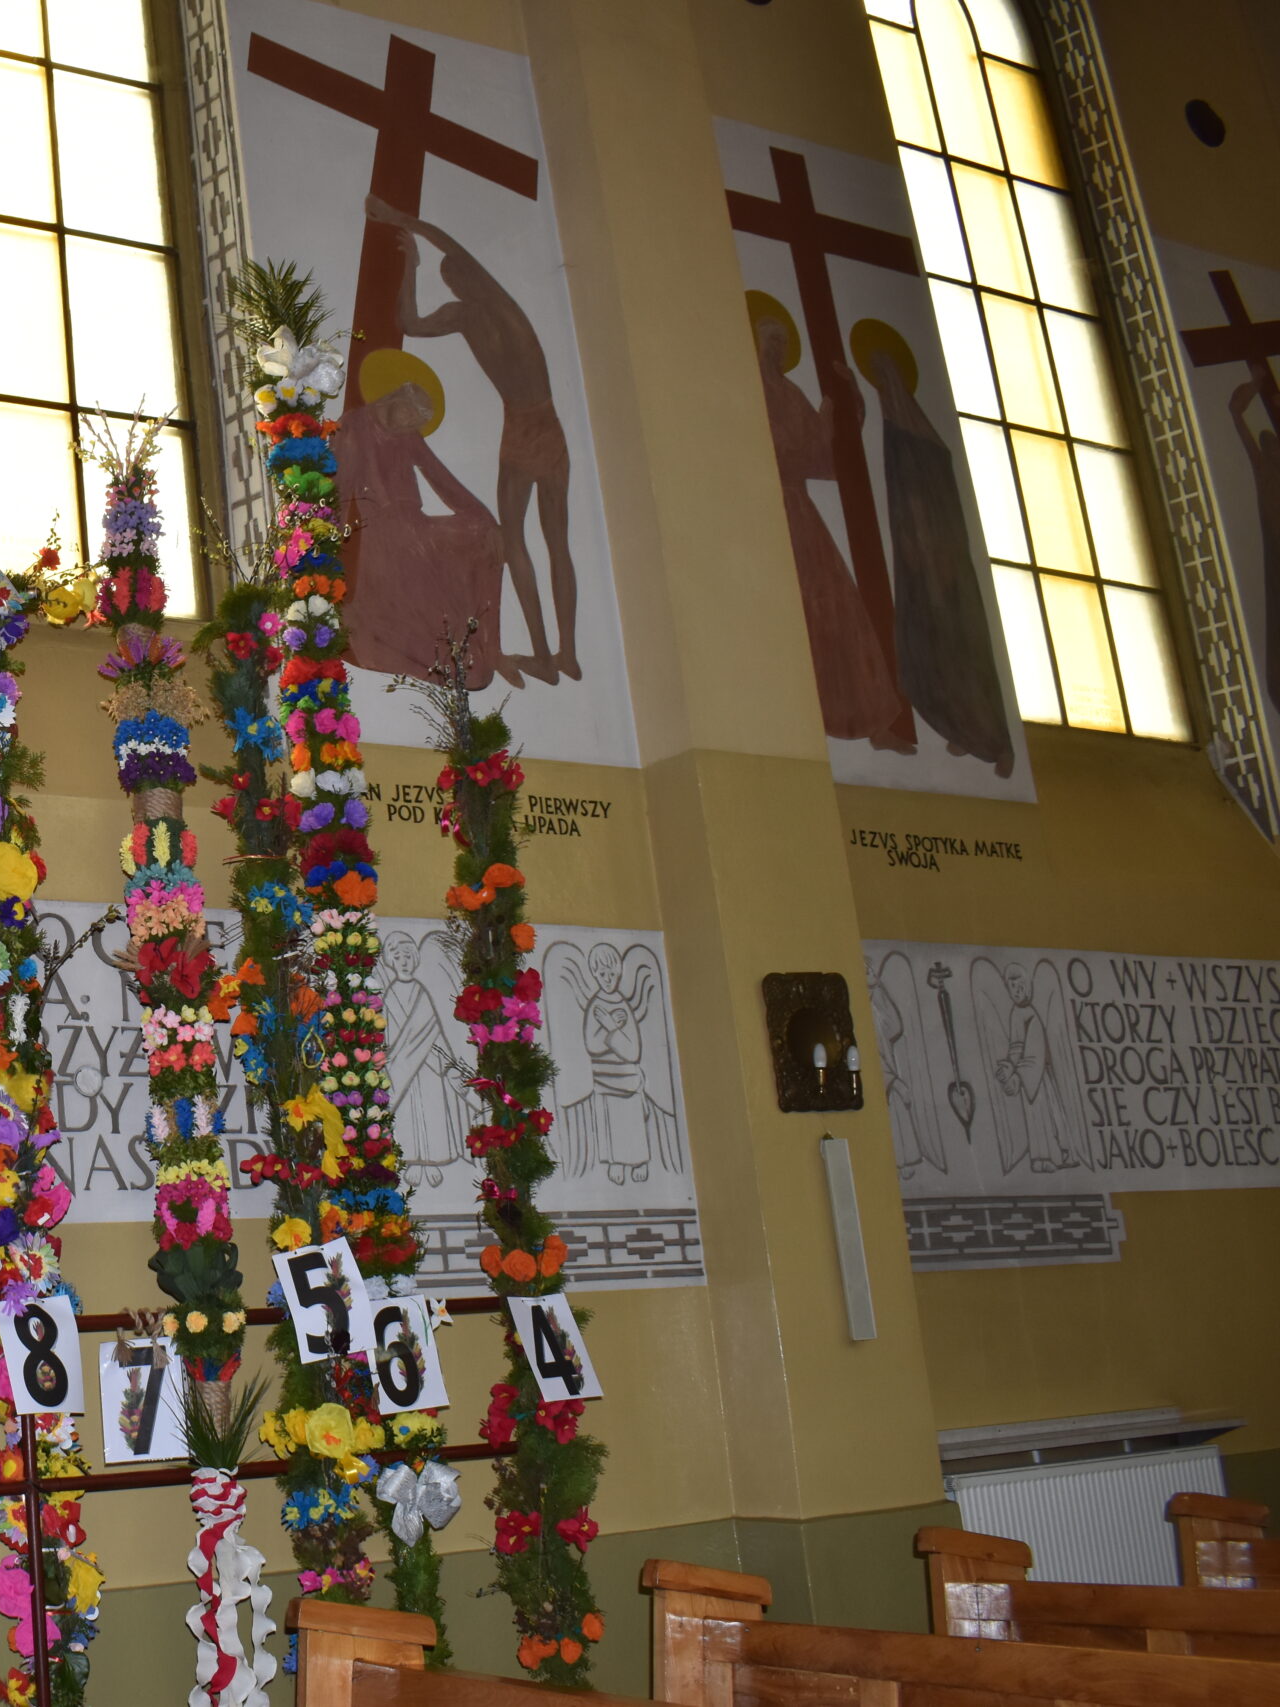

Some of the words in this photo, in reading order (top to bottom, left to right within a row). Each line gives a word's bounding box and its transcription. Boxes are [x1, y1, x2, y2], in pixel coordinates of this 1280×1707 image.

[387, 803, 425, 825] POD
[524, 814, 581, 837] UPADA
[528, 795, 612, 819] PIERWSZY
[904, 834, 970, 856] SPOTYKA
[1067, 957, 1093, 998] O
[1109, 957, 1156, 1000] WY
[1143, 1085, 1201, 1126] CZY
[1209, 1084, 1261, 1126] JEST
[1097, 1128, 1165, 1170] JAKO
[287, 1251, 351, 1356] 5
[14, 1305, 69, 1407] 8
[373, 1305, 421, 1408] 6
[533, 1305, 585, 1397] 4
[123, 1345, 167, 1456] 7
